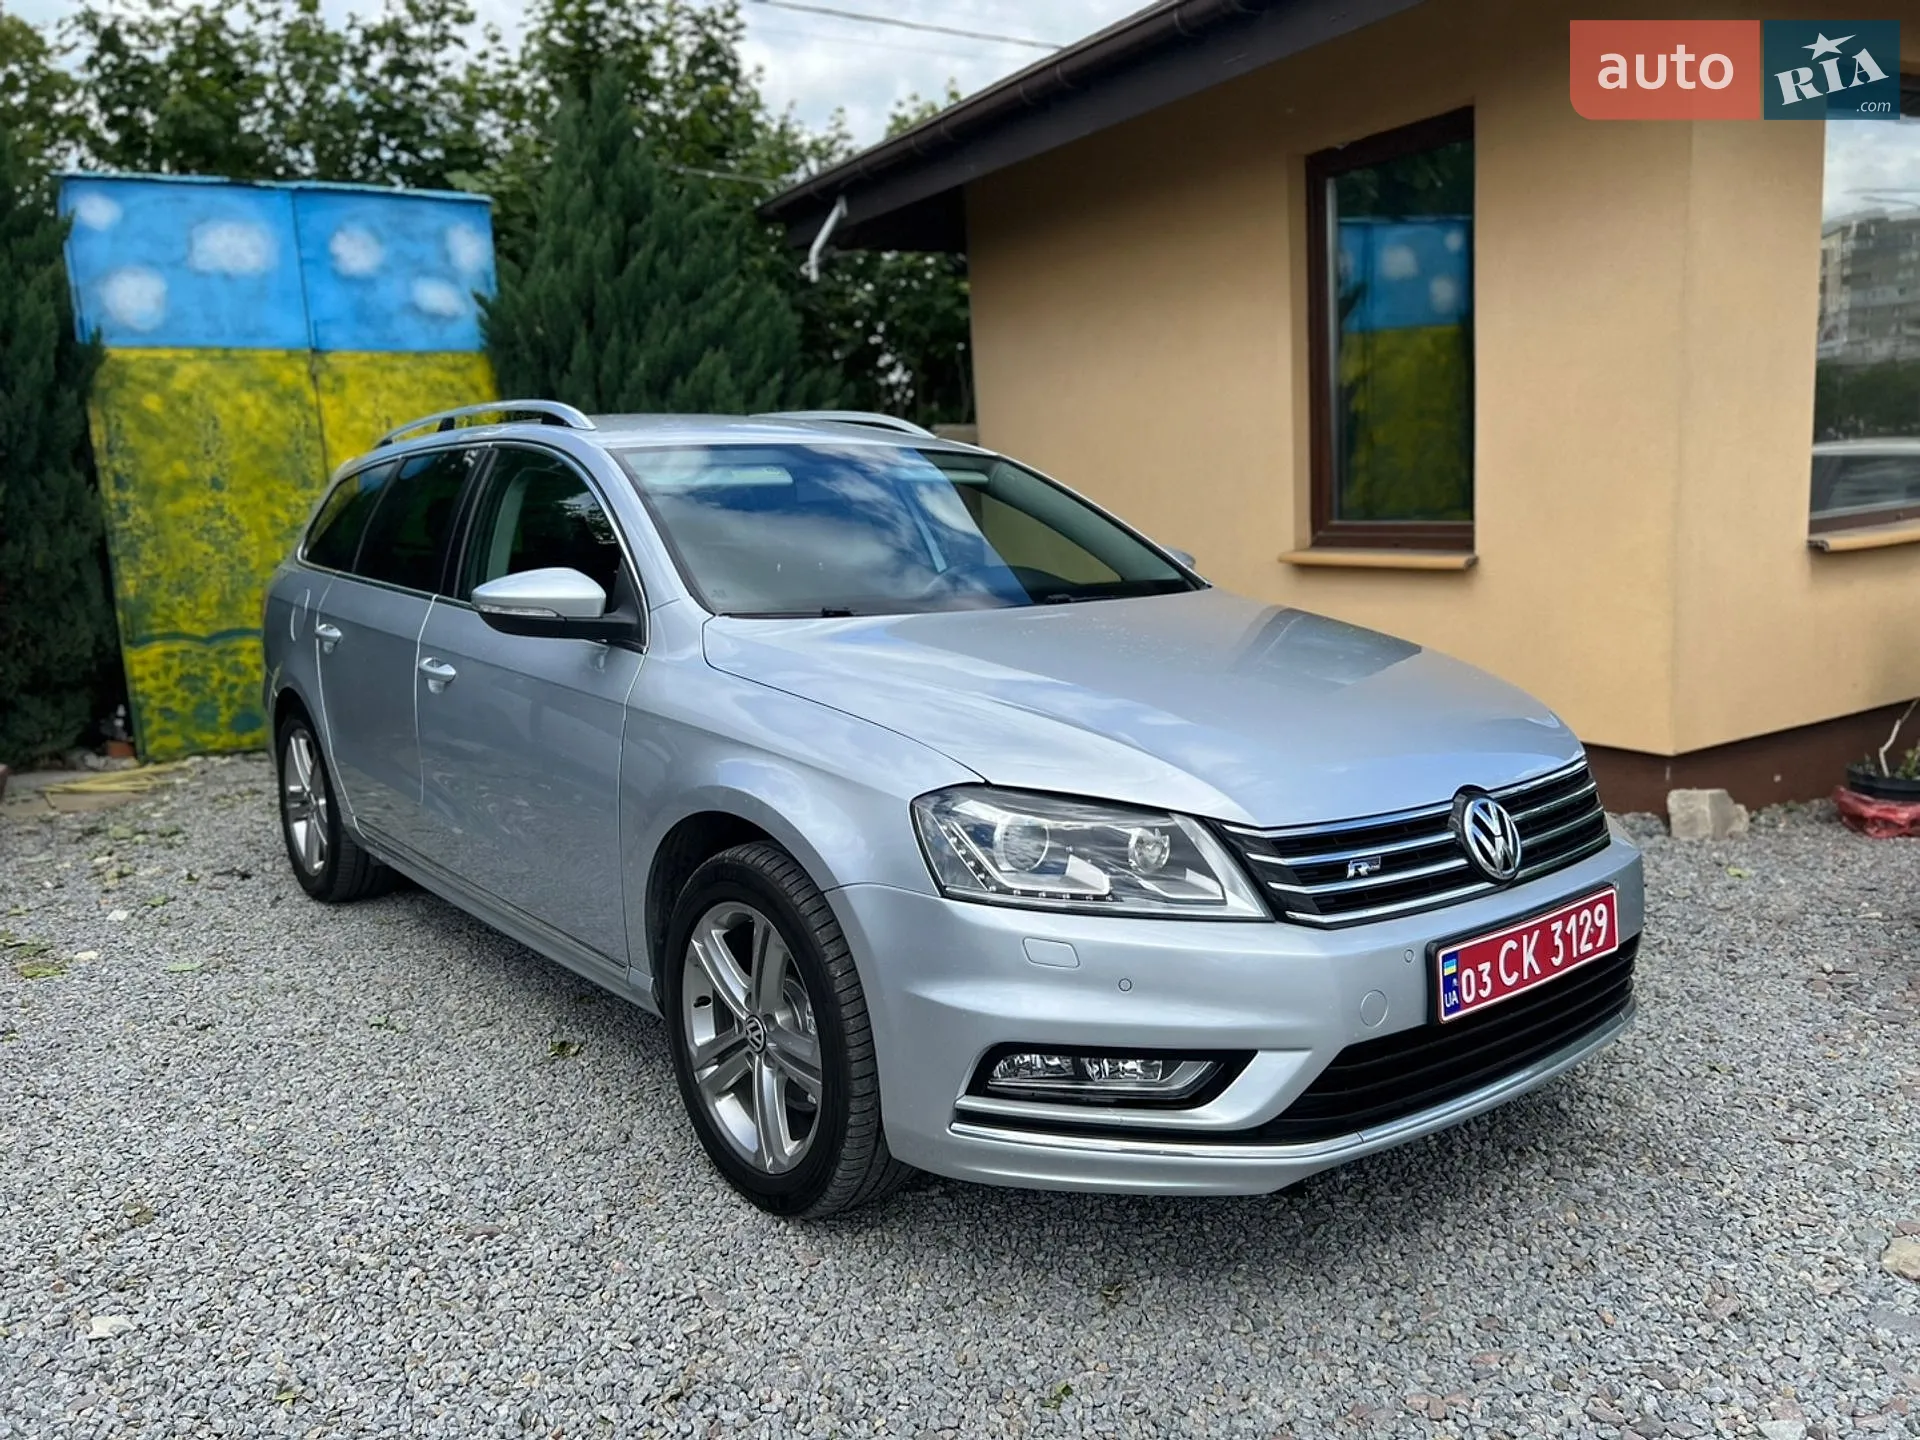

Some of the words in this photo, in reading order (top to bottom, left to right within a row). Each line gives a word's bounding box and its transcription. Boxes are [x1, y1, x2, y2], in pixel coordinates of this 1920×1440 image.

[1464, 799, 1522, 881] VW
[1461, 962, 1492, 1004] 03
[1498, 930, 1541, 986] CK
[1551, 903, 1608, 967] 3129
[1444, 990, 1459, 1008] UA
